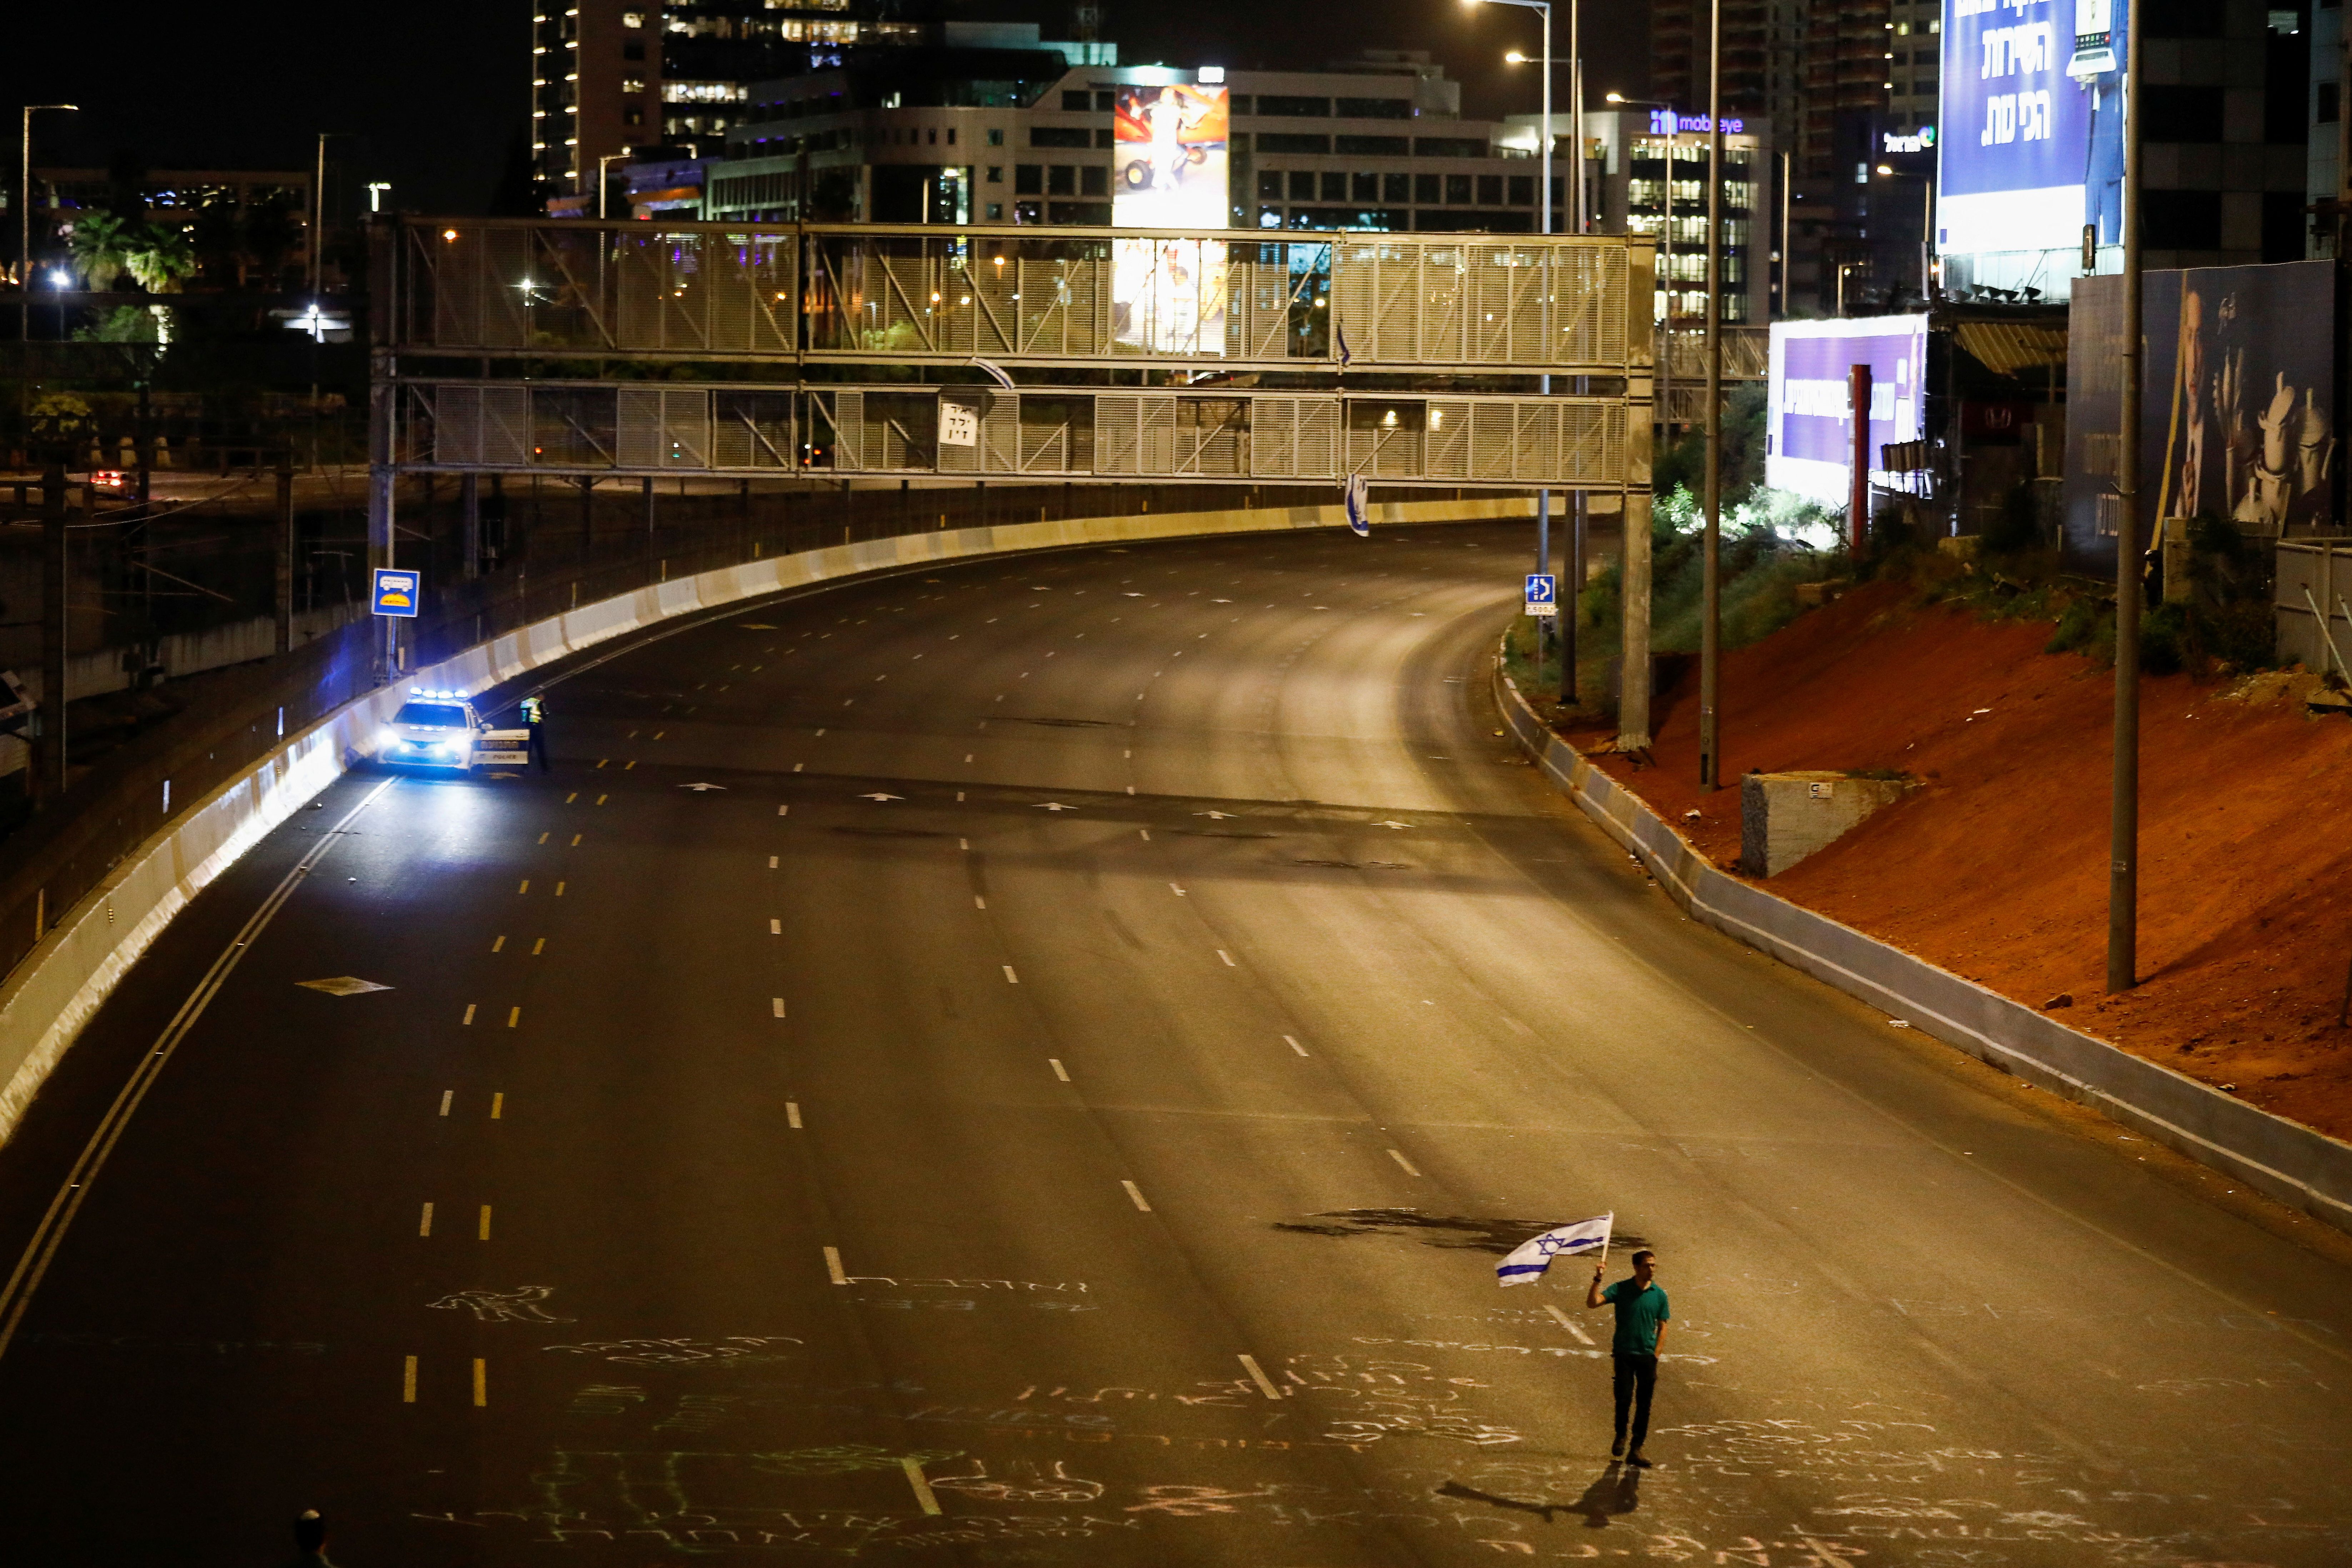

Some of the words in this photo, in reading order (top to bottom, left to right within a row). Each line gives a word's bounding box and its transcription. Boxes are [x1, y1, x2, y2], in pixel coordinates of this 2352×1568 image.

[1981, 21, 2051, 79] השירות
[1678, 113, 1743, 135] mobeye
[2018, 89, 2050, 141] הכי
